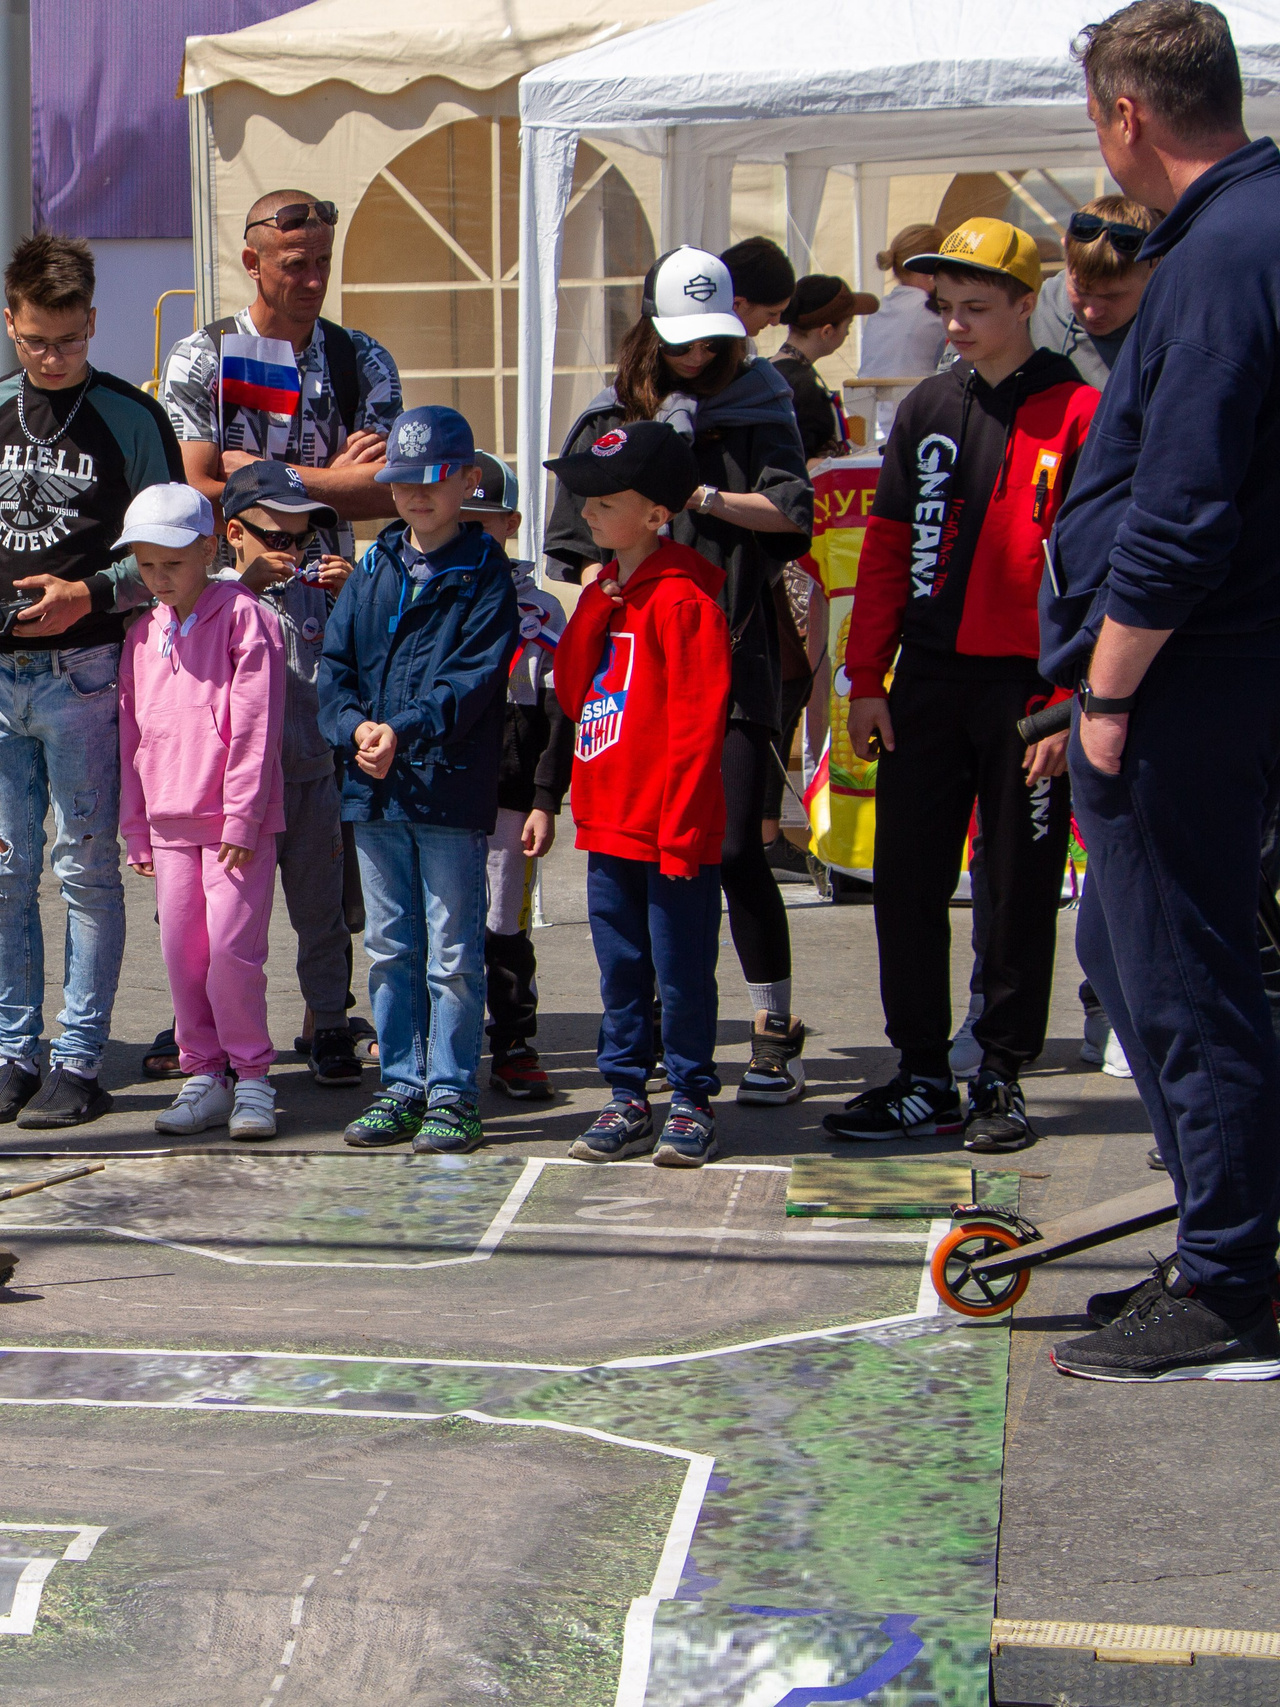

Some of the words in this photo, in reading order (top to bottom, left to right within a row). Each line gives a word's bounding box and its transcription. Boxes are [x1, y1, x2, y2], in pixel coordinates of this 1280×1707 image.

[46, 505, 79, 518] DIVISION
[581, 696, 618, 724] SSIA
[575, 1195, 665, 1221] 2
